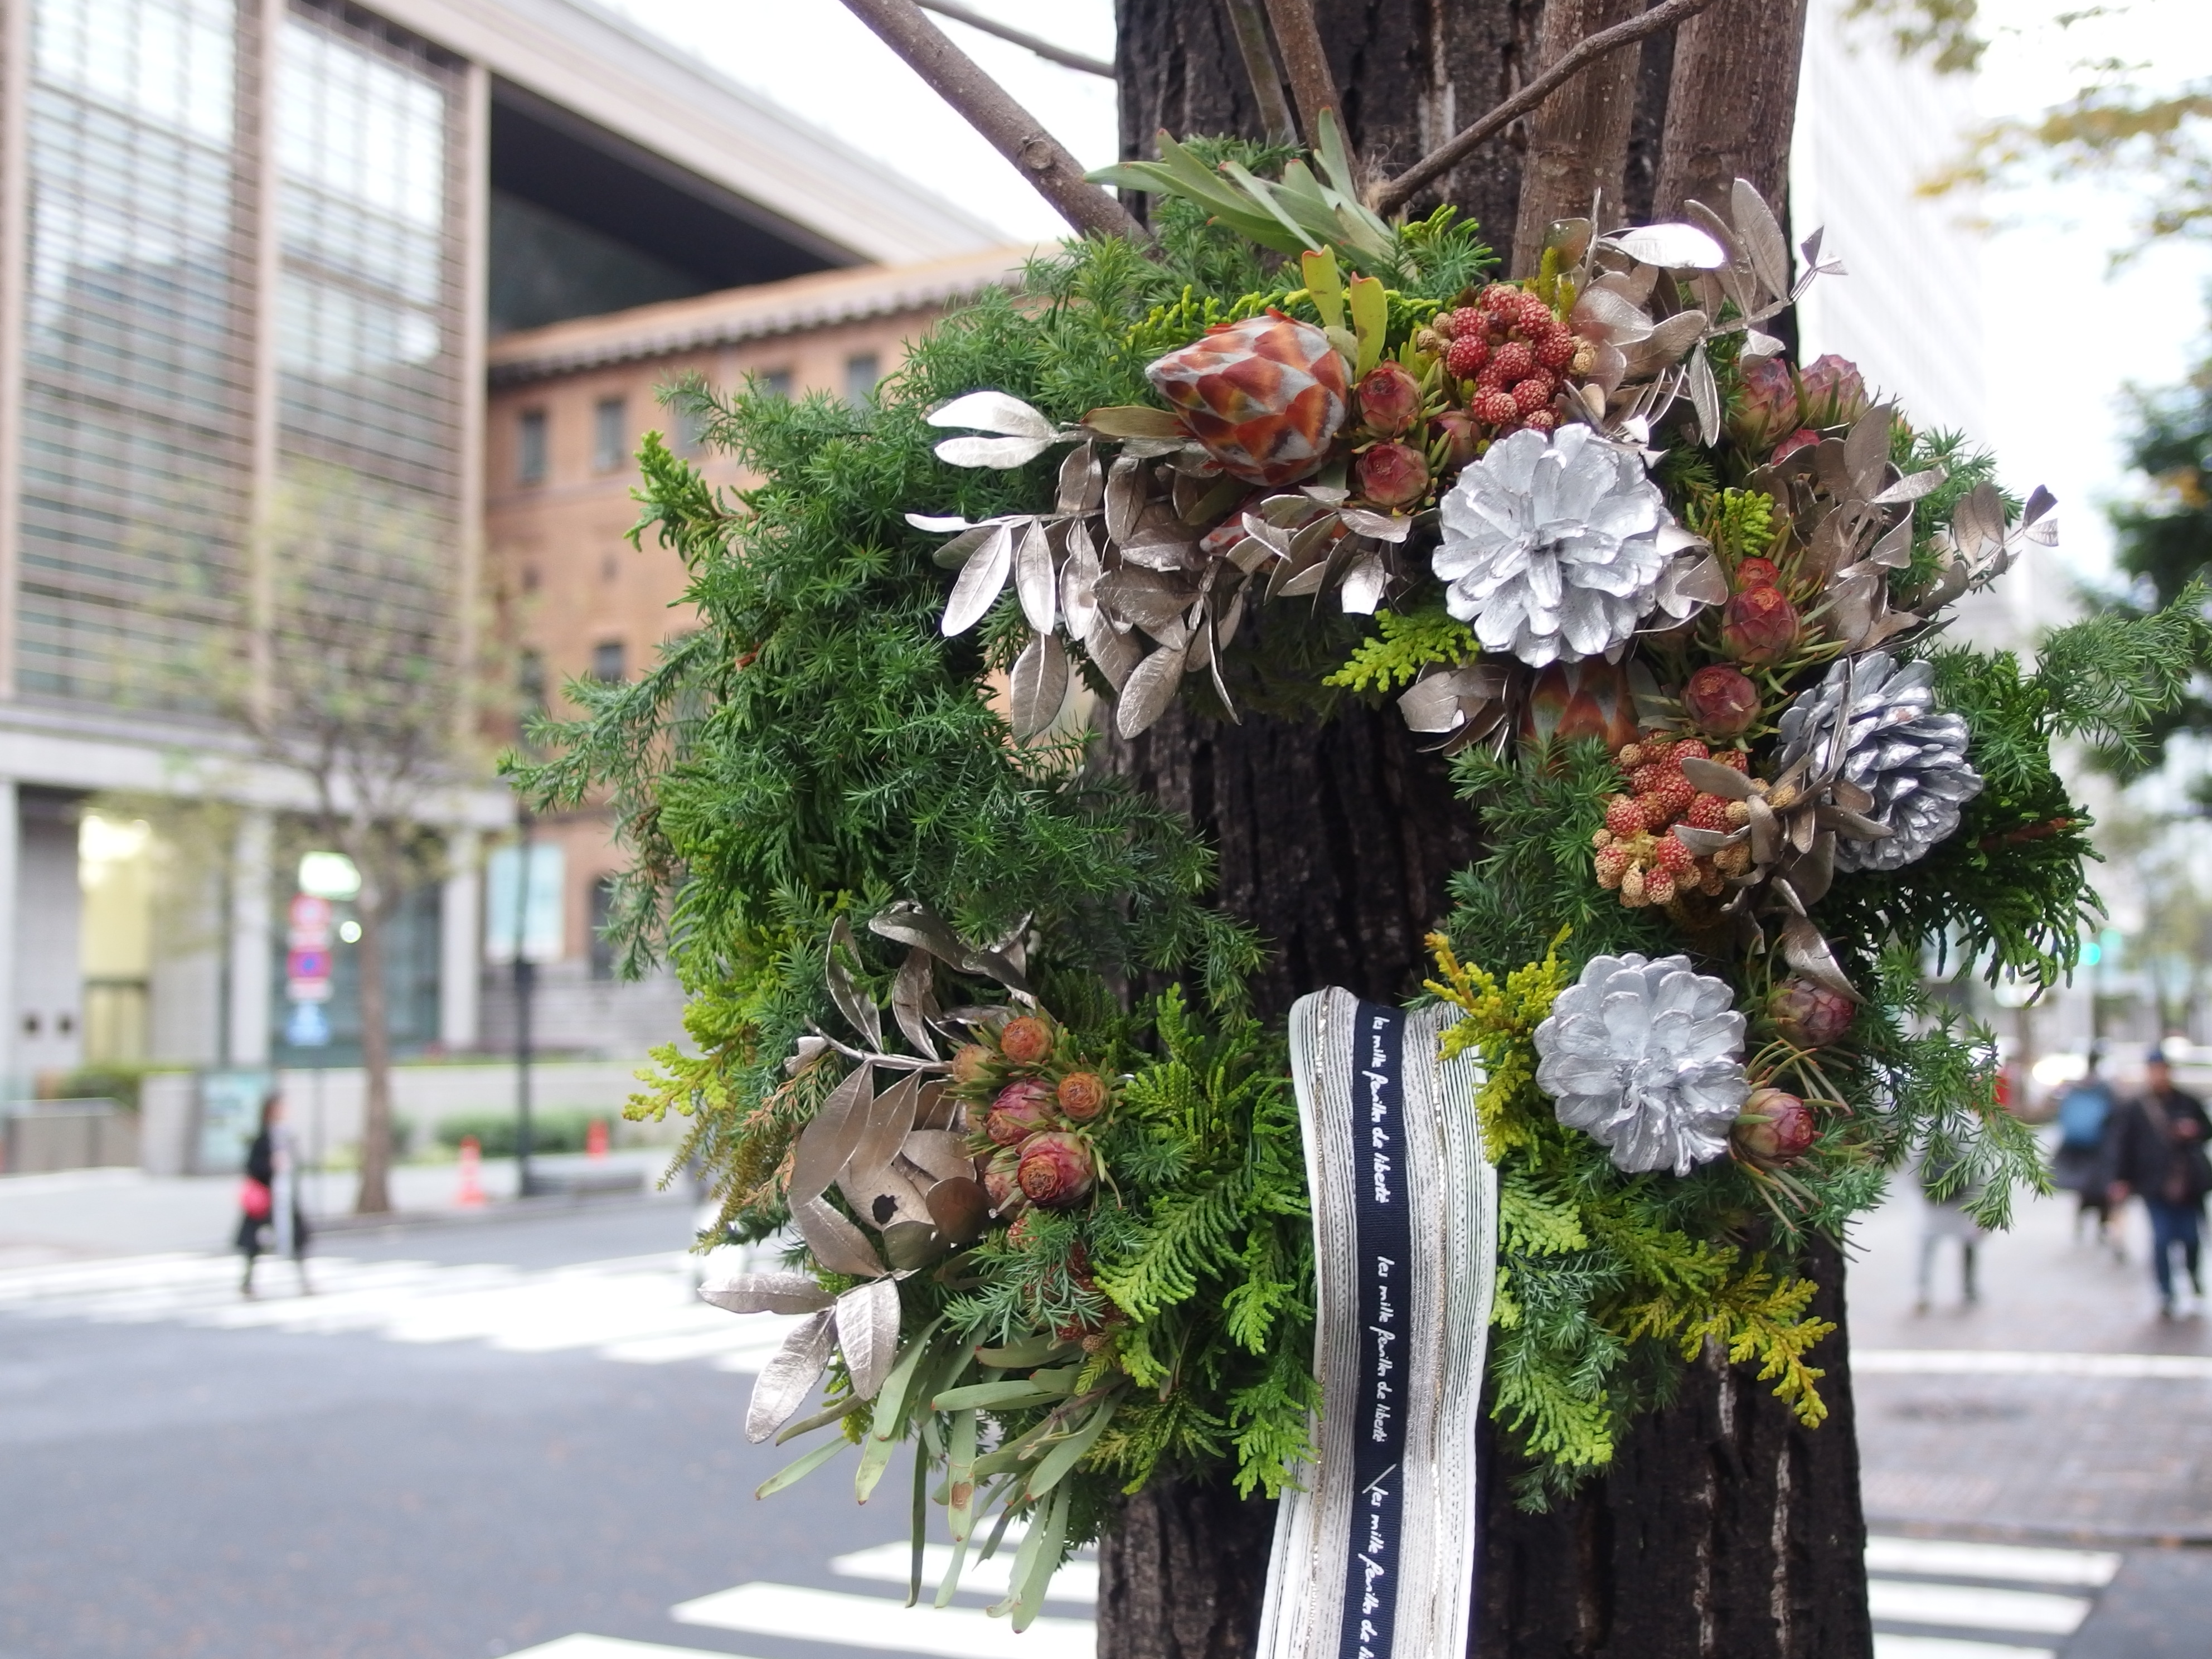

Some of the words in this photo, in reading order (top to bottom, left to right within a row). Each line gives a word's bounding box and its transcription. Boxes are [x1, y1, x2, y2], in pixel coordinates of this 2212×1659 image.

[1371, 1035, 1386, 1068] mille
[1372, 1127, 1389, 1148] de
[1377, 1256, 1395, 1277] les
[1379, 1285, 1394, 1323] mille
[1377, 1381, 1393, 1400] de
[1371, 1486, 1389, 1507] les
[1368, 1514, 1384, 1554] mille
[1360, 1619, 1377, 1642] de
